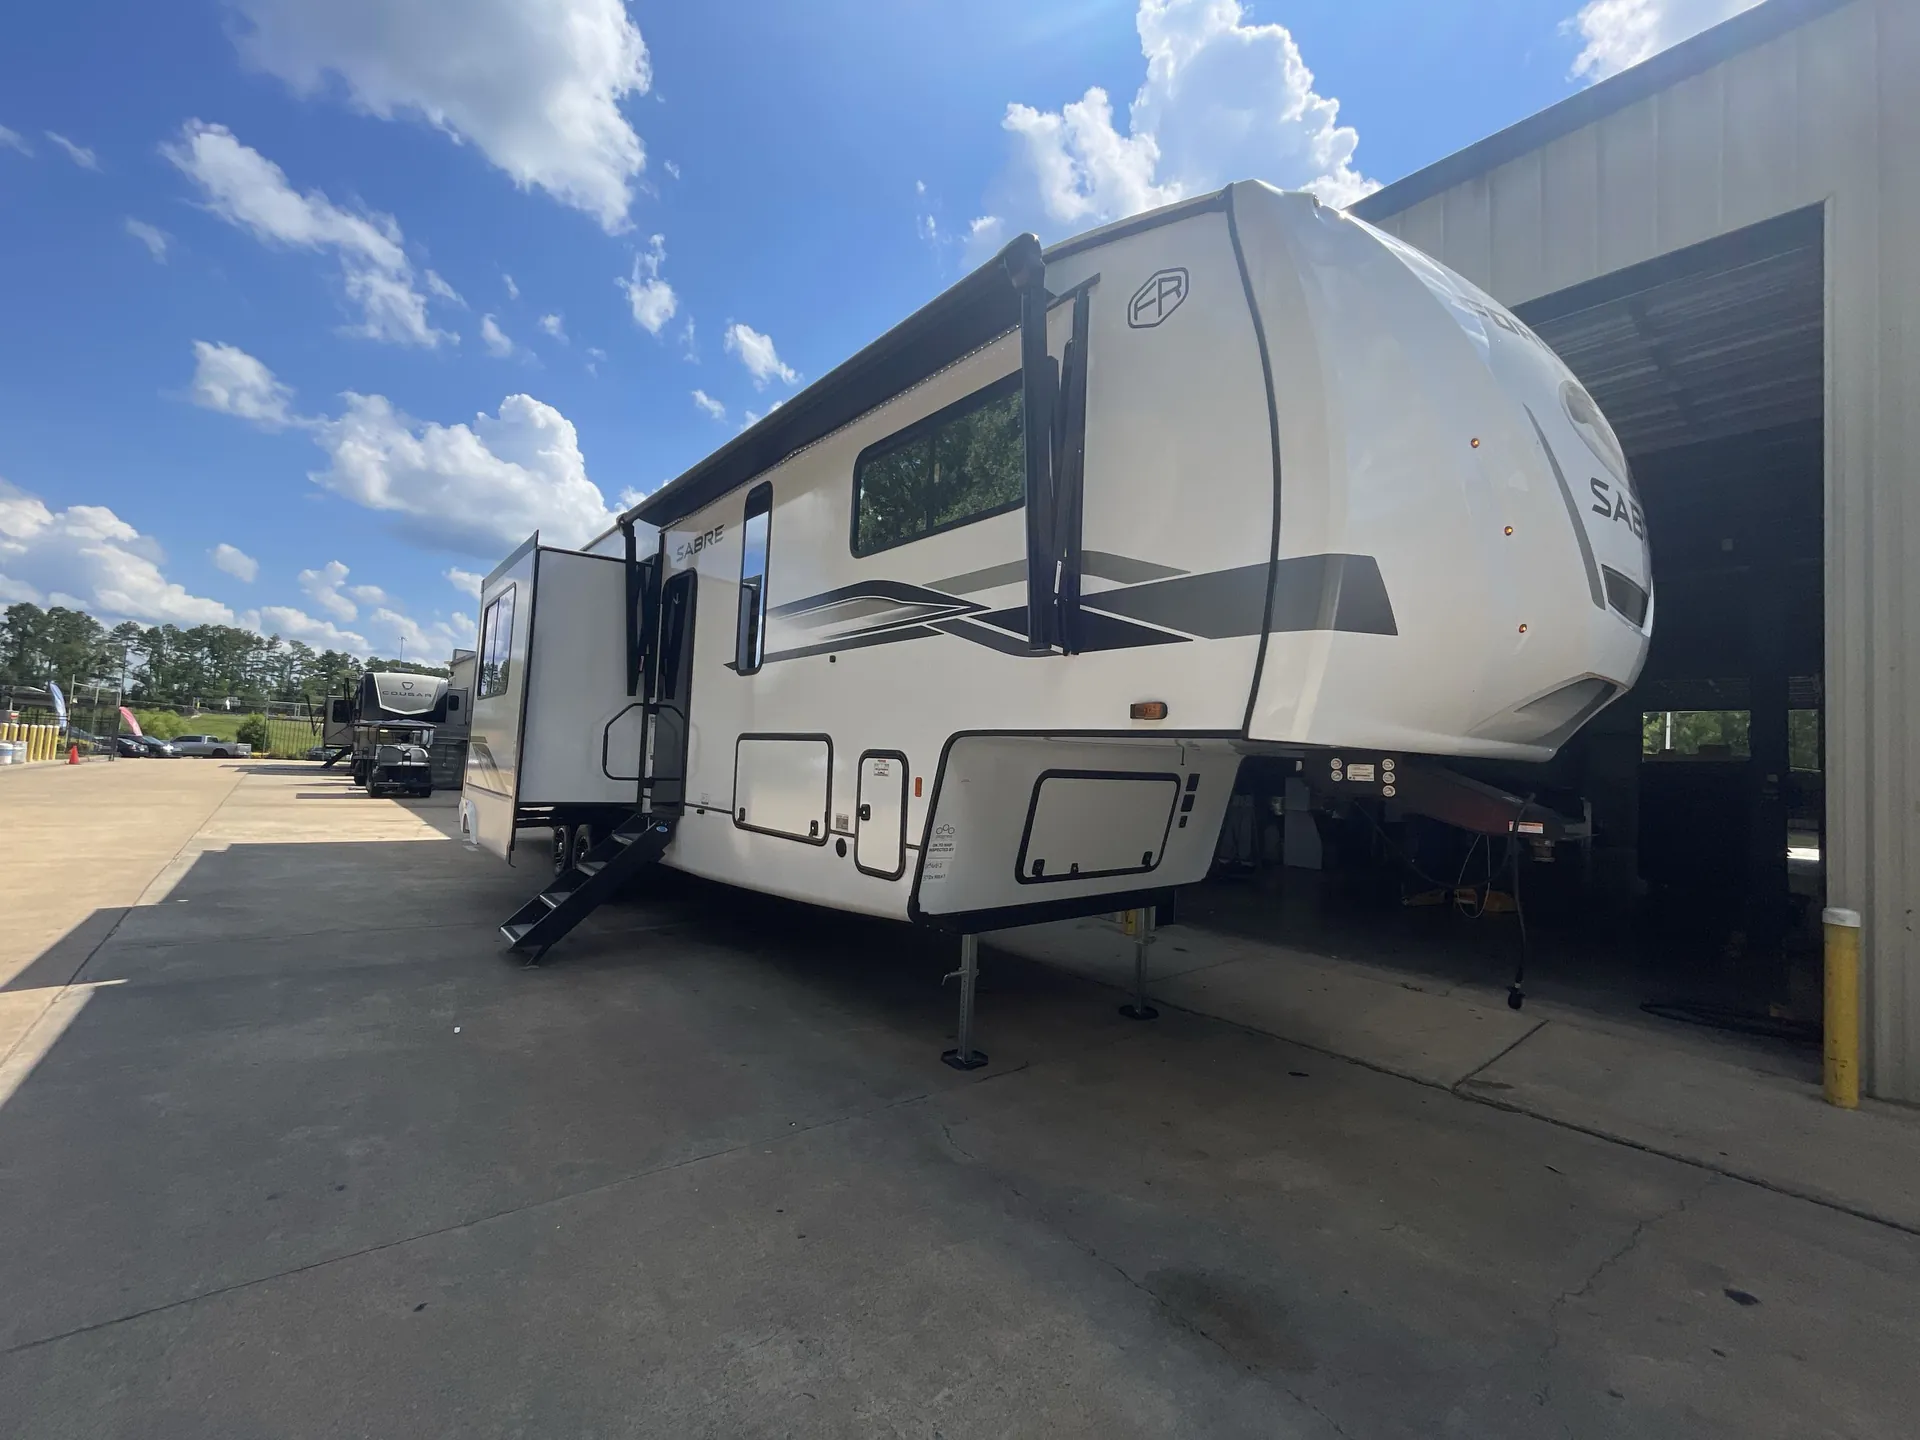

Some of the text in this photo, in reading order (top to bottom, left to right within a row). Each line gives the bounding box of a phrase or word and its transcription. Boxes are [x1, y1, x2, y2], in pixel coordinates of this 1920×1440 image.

[1590, 476, 1647, 546] SAB
[676, 523, 725, 562] SABRE
[382, 690, 432, 698] COUGAR
